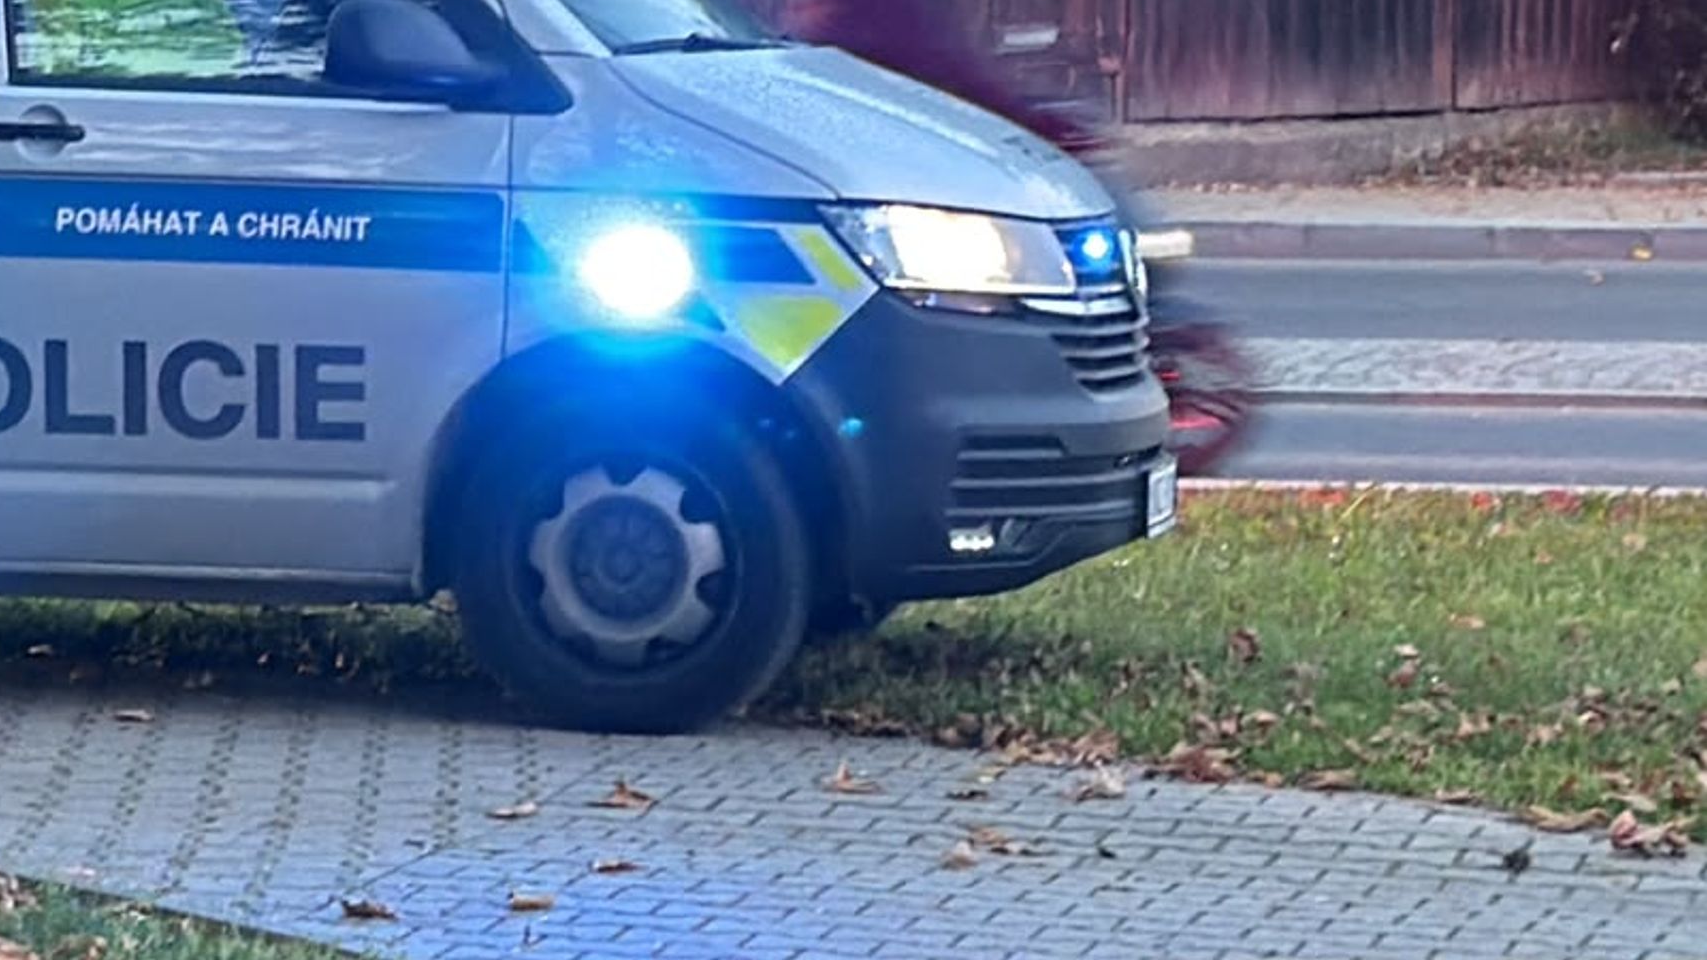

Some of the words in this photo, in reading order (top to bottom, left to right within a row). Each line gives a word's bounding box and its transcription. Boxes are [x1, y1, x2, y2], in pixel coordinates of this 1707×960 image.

[55, 203, 201, 236] POMÁHAT
[209, 212, 229, 237] A
[237, 208, 371, 241] CHRÁNIT
